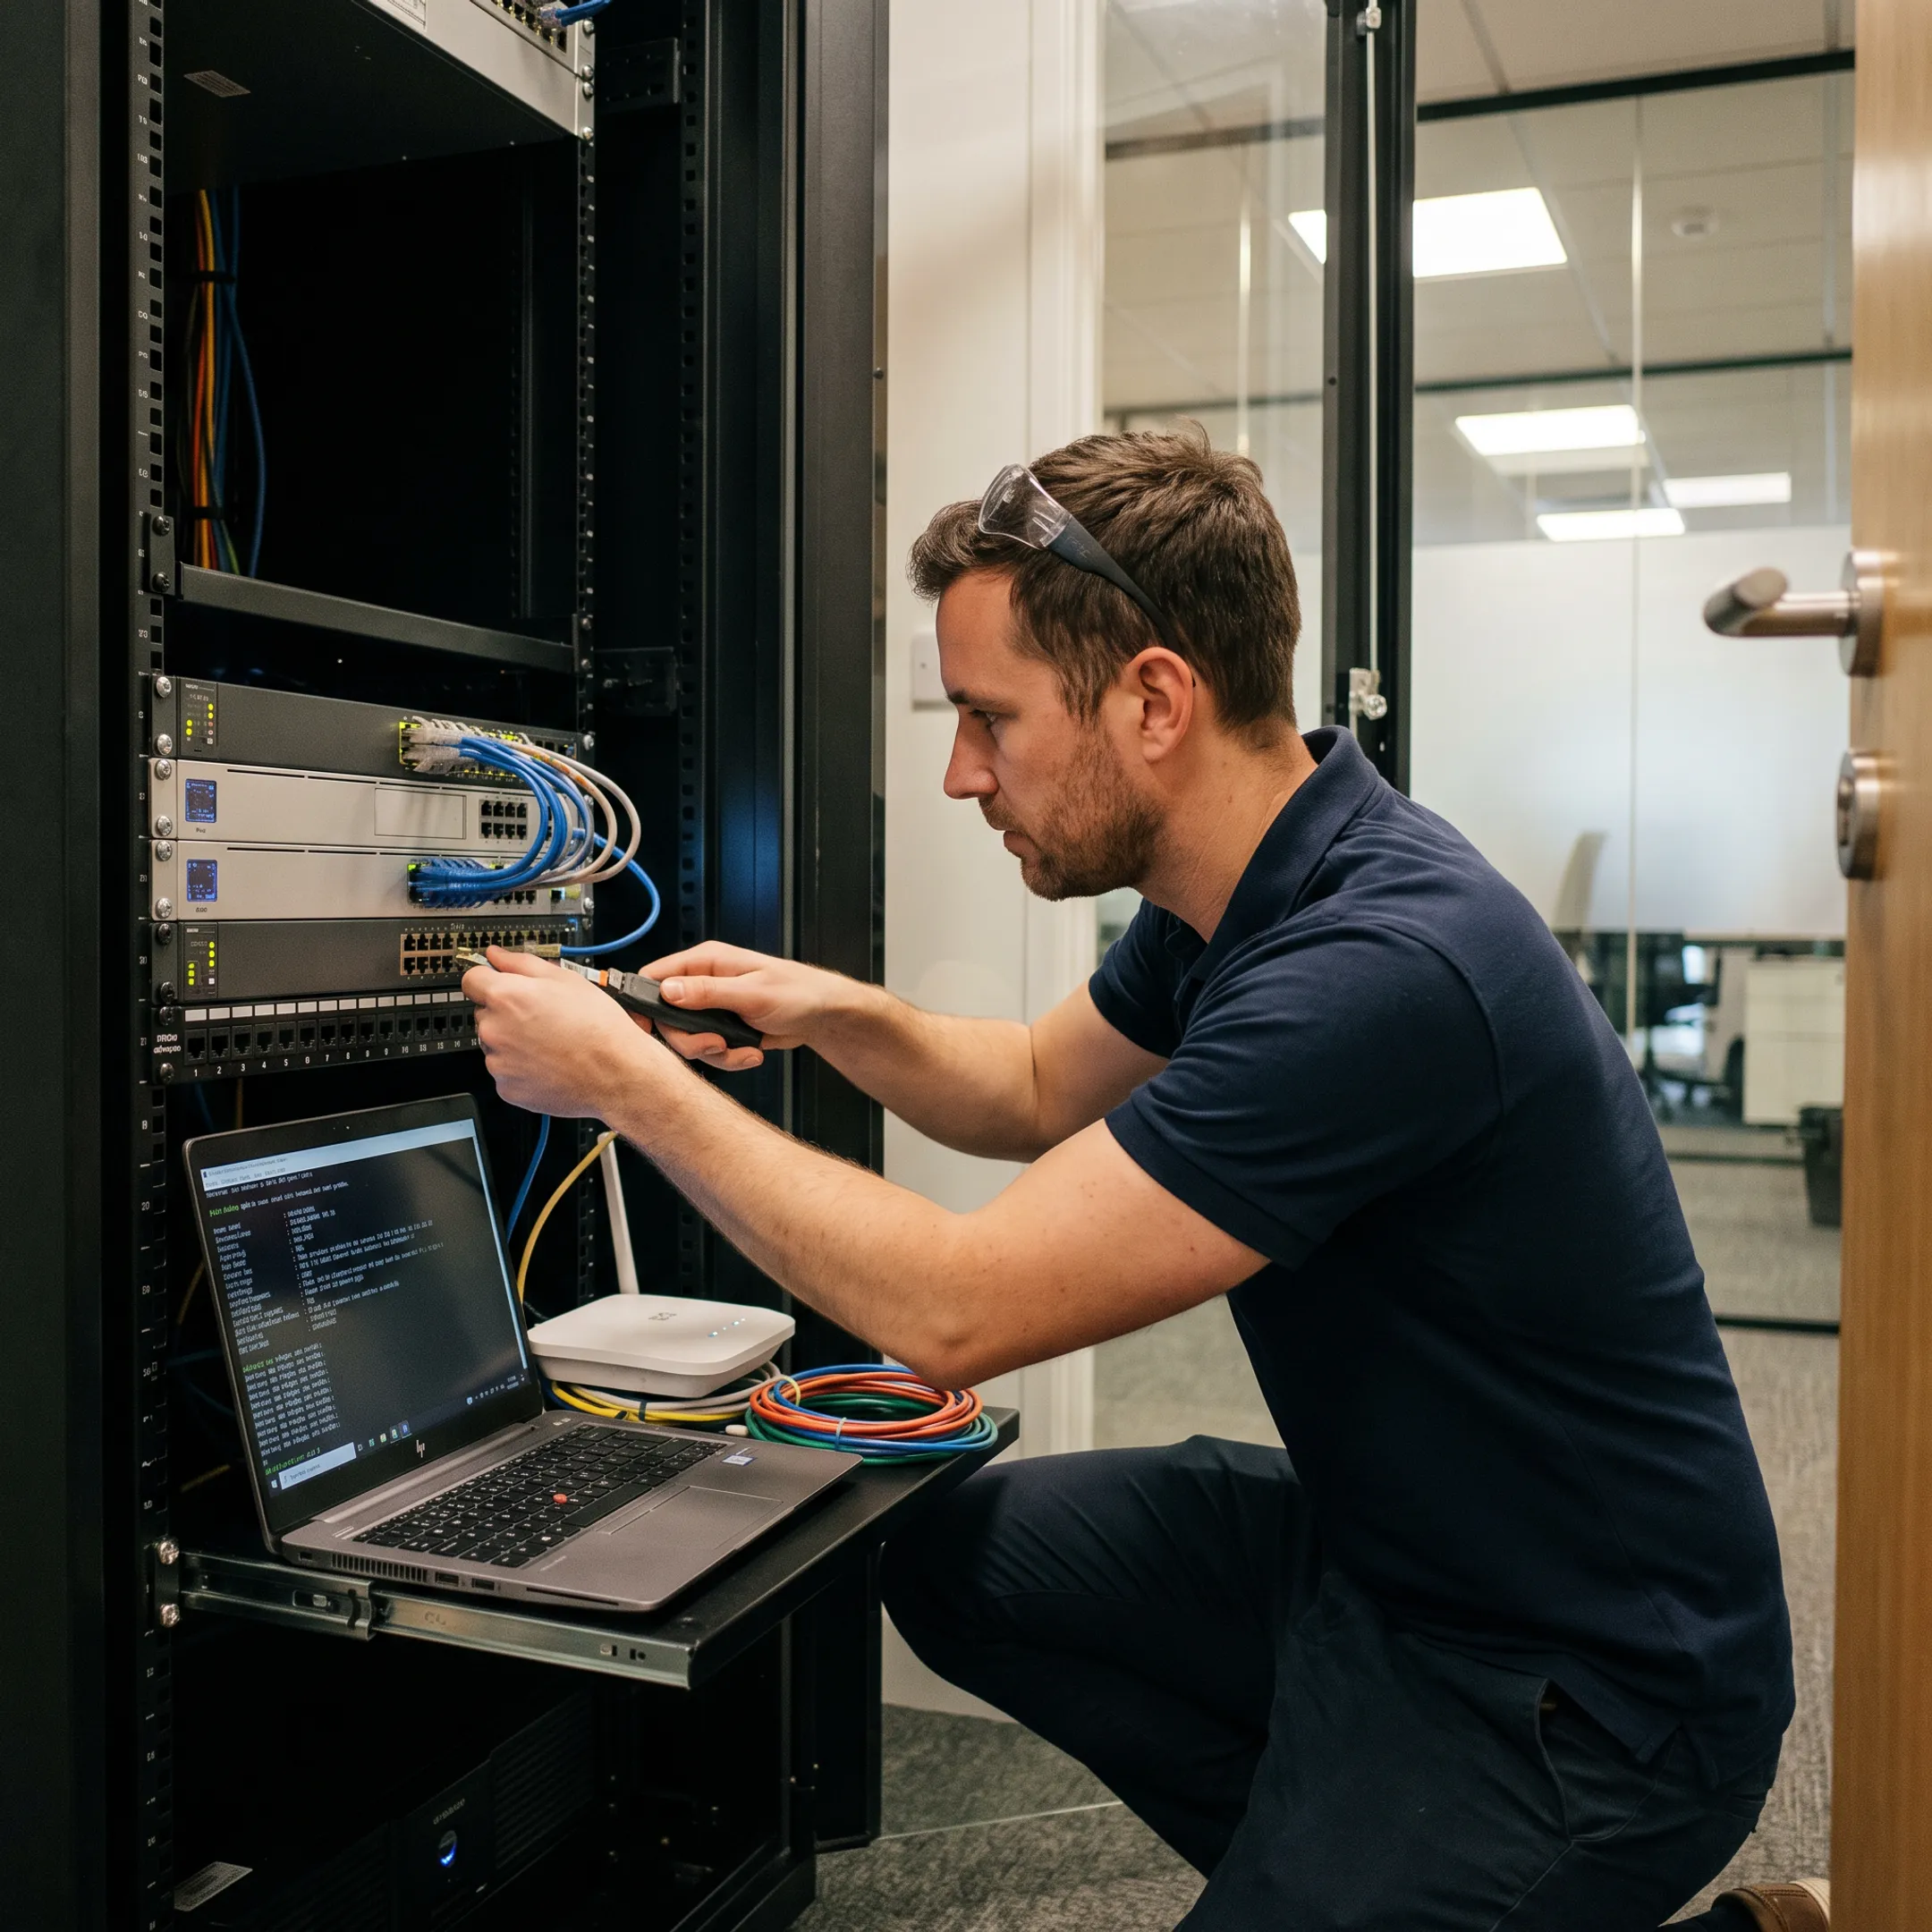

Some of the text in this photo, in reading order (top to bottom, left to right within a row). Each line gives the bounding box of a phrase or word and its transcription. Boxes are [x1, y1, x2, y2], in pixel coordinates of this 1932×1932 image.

[216, 1066, 222, 1074] 2
[241, 1063, 246, 1072] 3
[261, 1061, 267, 1069] 4
[284, 1058, 289, 1066] 5
[416, 1439, 426, 1458] hp
